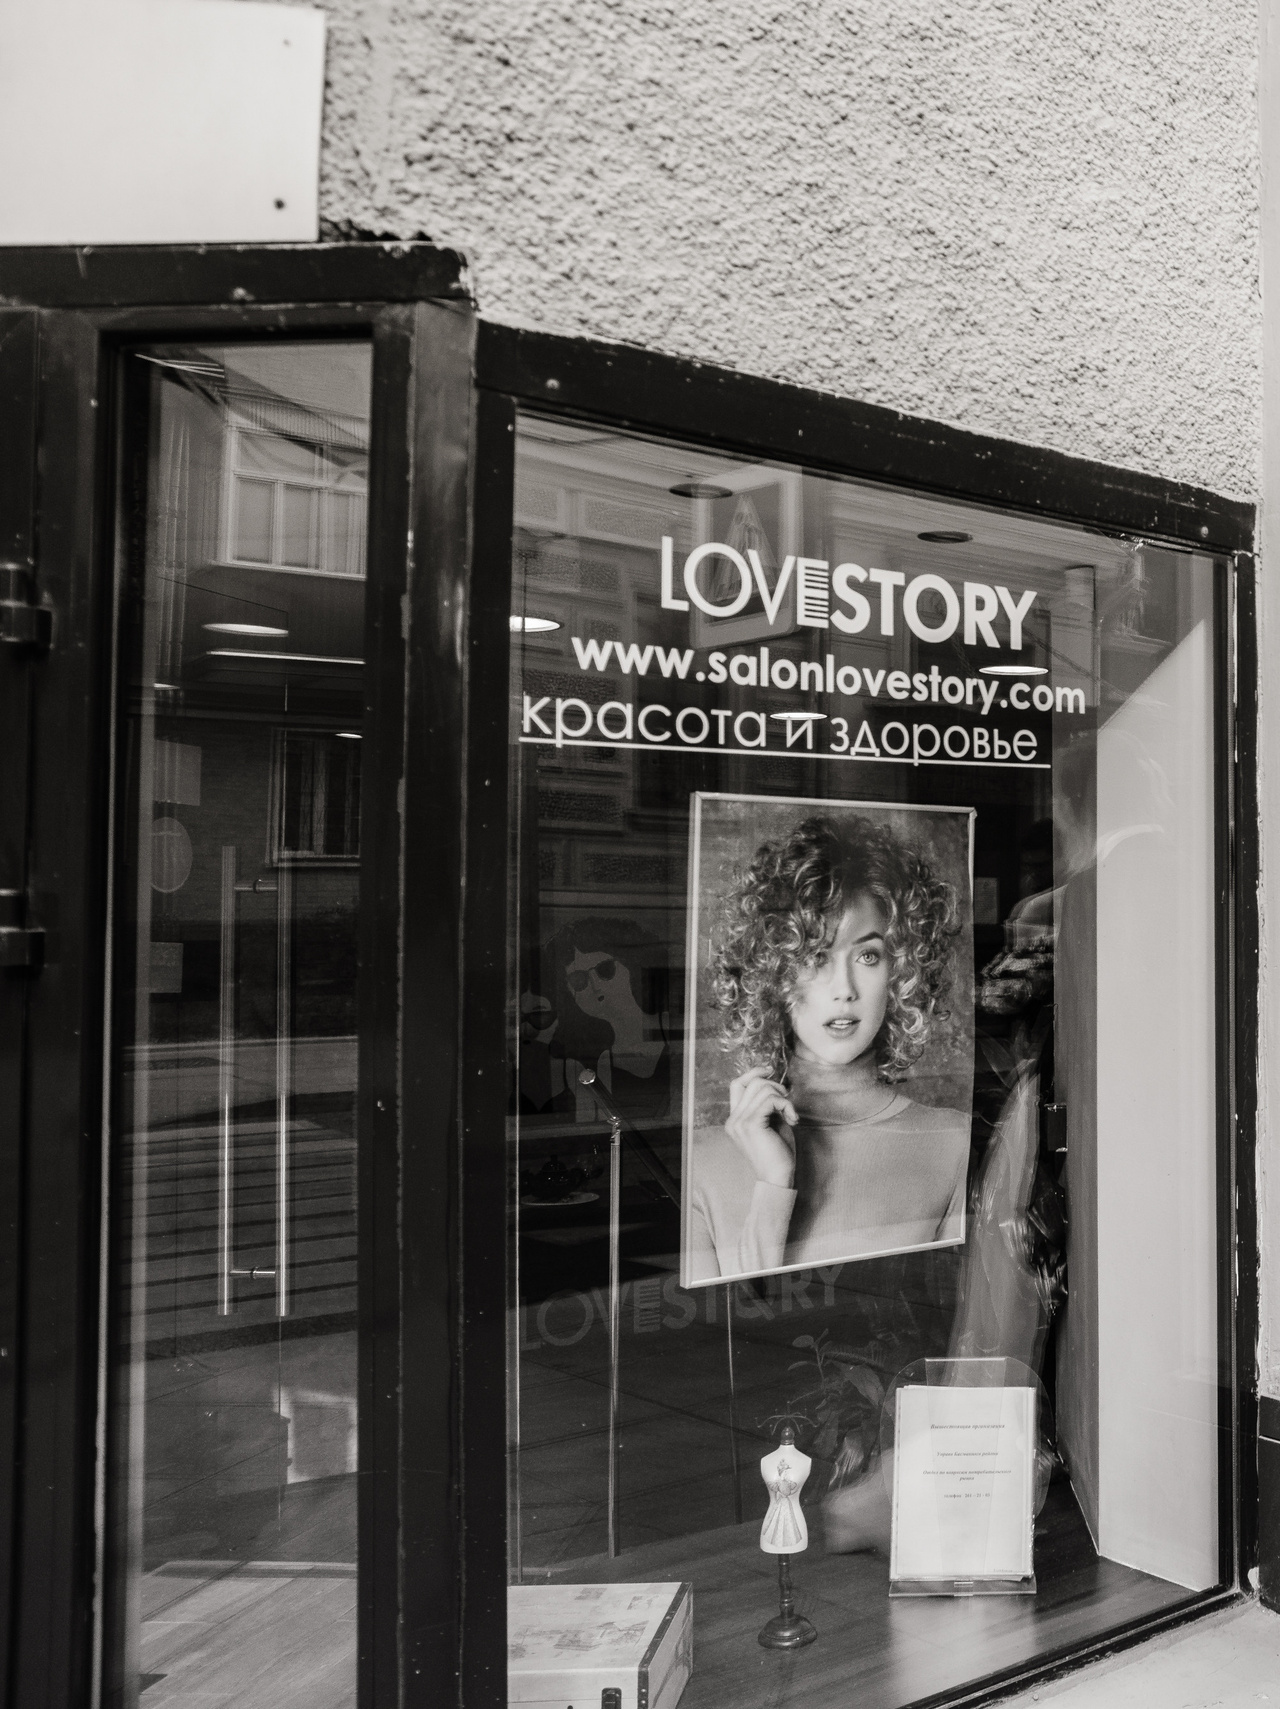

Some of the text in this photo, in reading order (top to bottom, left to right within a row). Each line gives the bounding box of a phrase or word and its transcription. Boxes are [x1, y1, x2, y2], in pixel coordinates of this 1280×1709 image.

[660, 535, 1038, 650] LOVESTORY
[571, 636, 1088, 715] www.salonlovestory.com
[522, 693, 1039, 767] красота и здоровье
